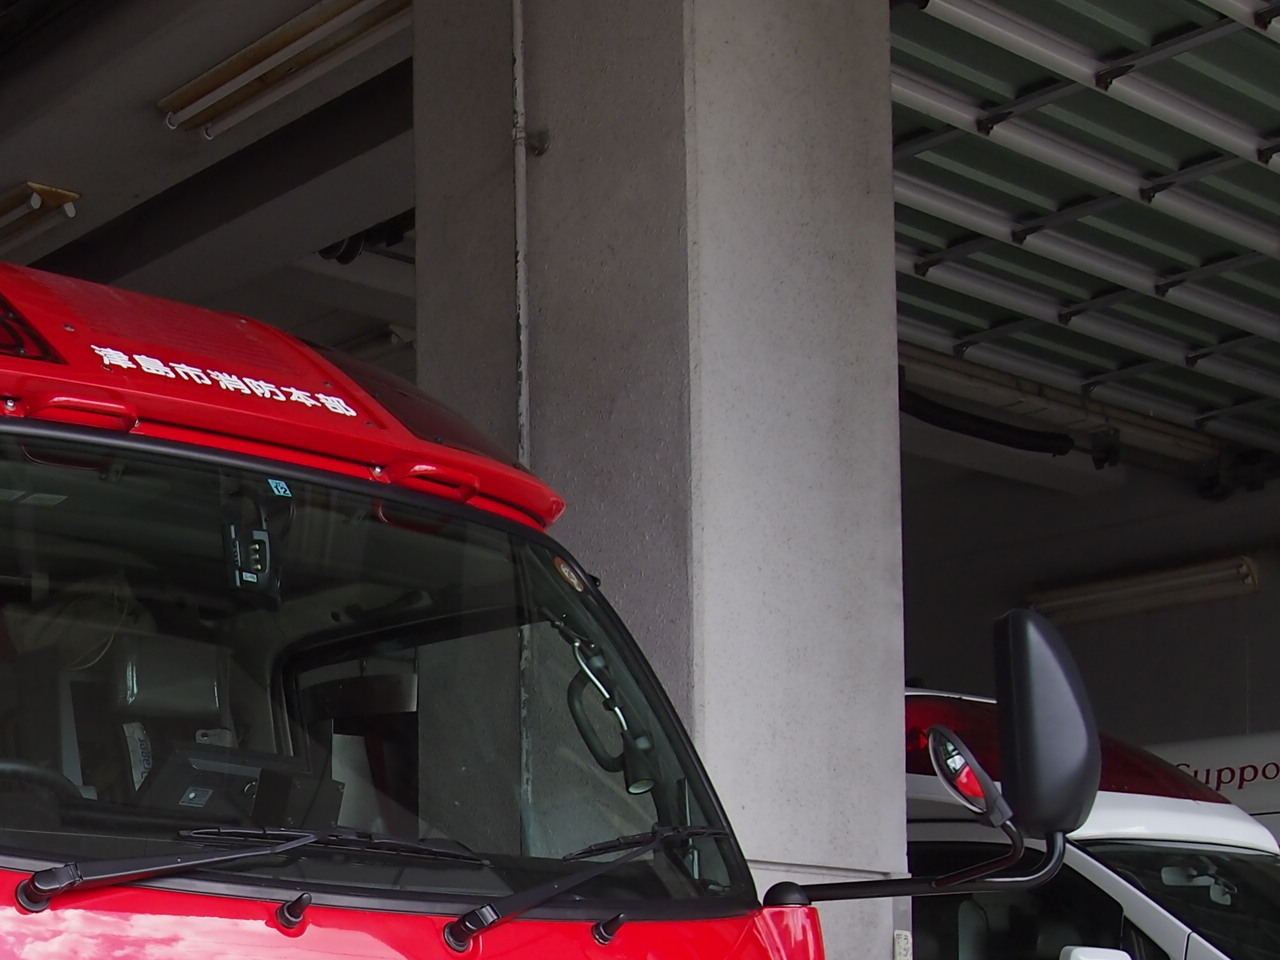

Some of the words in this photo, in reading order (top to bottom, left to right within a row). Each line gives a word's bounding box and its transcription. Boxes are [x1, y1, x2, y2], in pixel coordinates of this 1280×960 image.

[91, 345, 358, 417] 津島市消防本部
[1176, 762, 1280, 791] uppo
